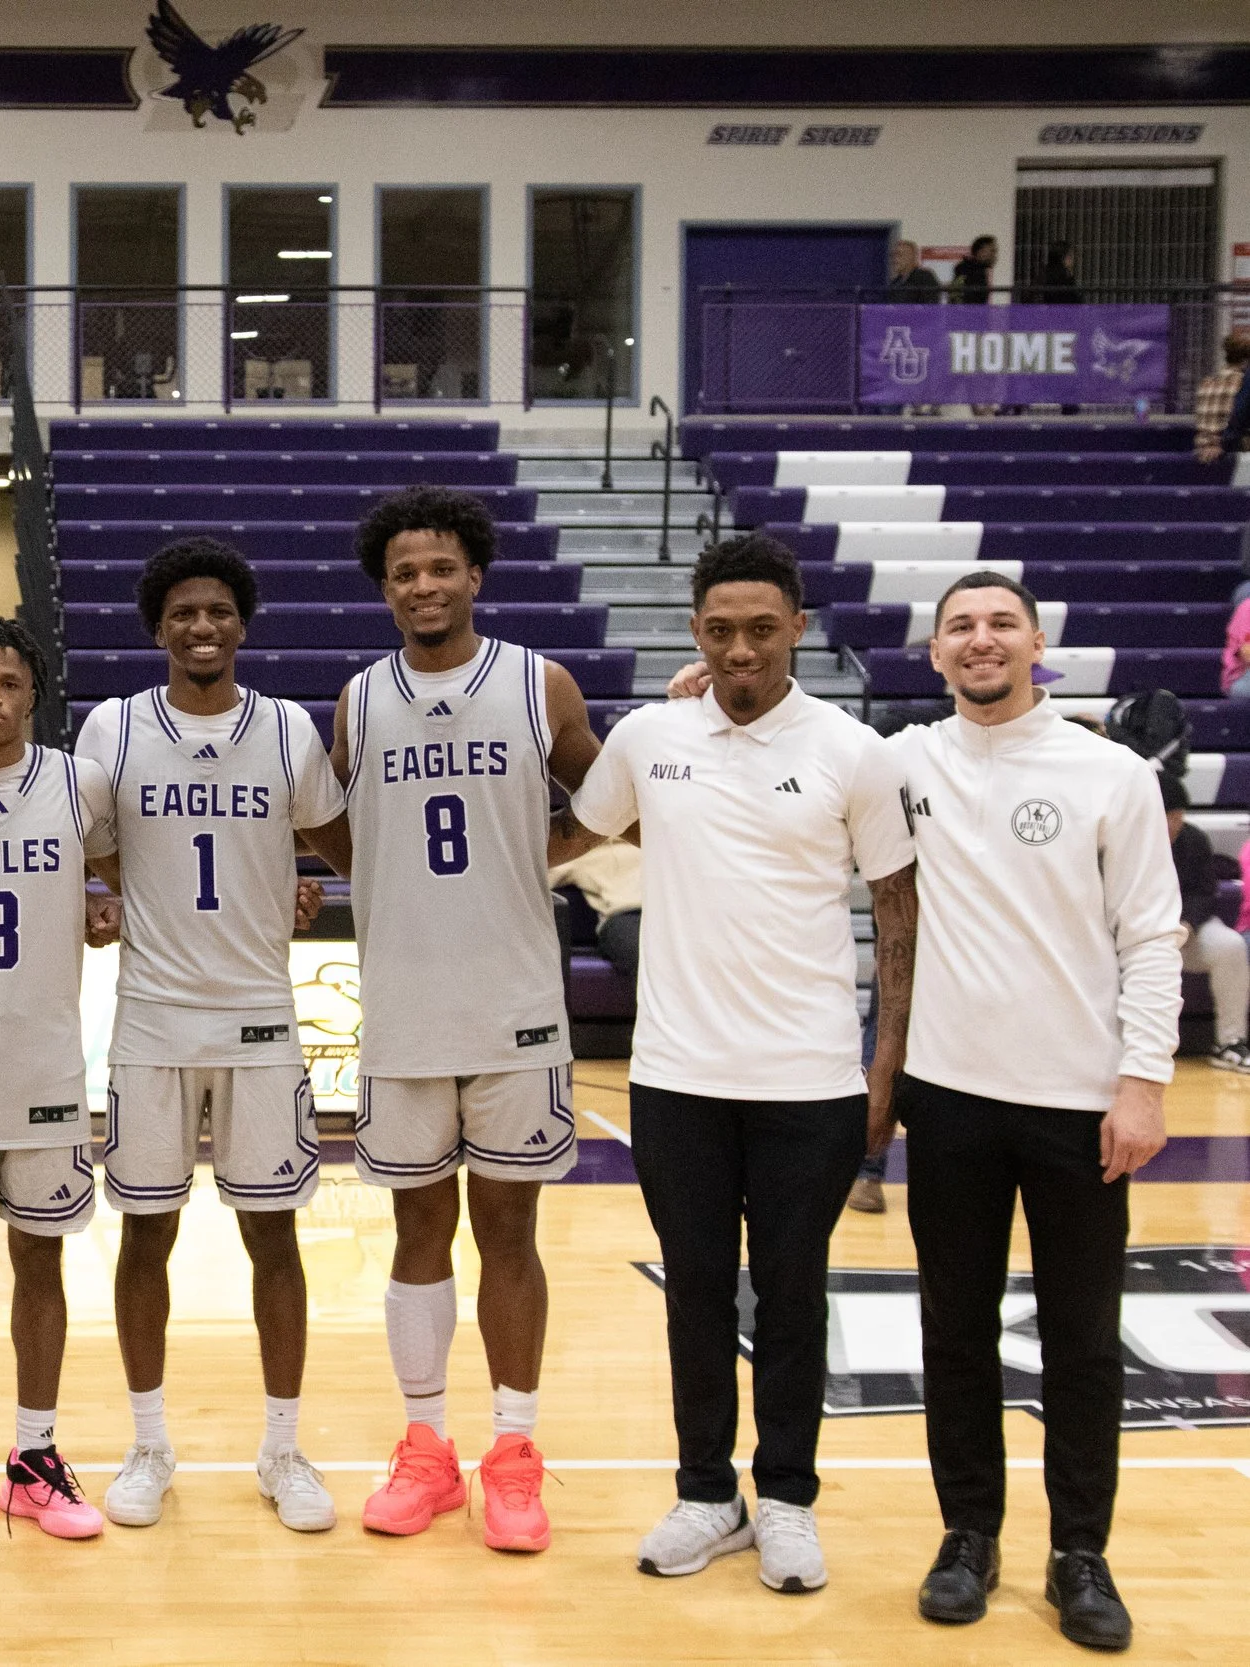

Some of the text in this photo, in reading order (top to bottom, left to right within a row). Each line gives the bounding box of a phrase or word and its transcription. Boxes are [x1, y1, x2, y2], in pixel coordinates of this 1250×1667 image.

[707, 125, 882, 145] SPIRIT STORE
[1038, 123, 1207, 144] CONCESSIONS
[950, 331, 1078, 373] HOME
[382, 740, 508, 784] EAGLES
[649, 763, 691, 780] AVILA
[140, 783, 270, 819] EAGLES
[424, 794, 469, 876] 8
[192, 832, 220, 912] 1
[1122, 1396, 1250, 1410] ANSAS
